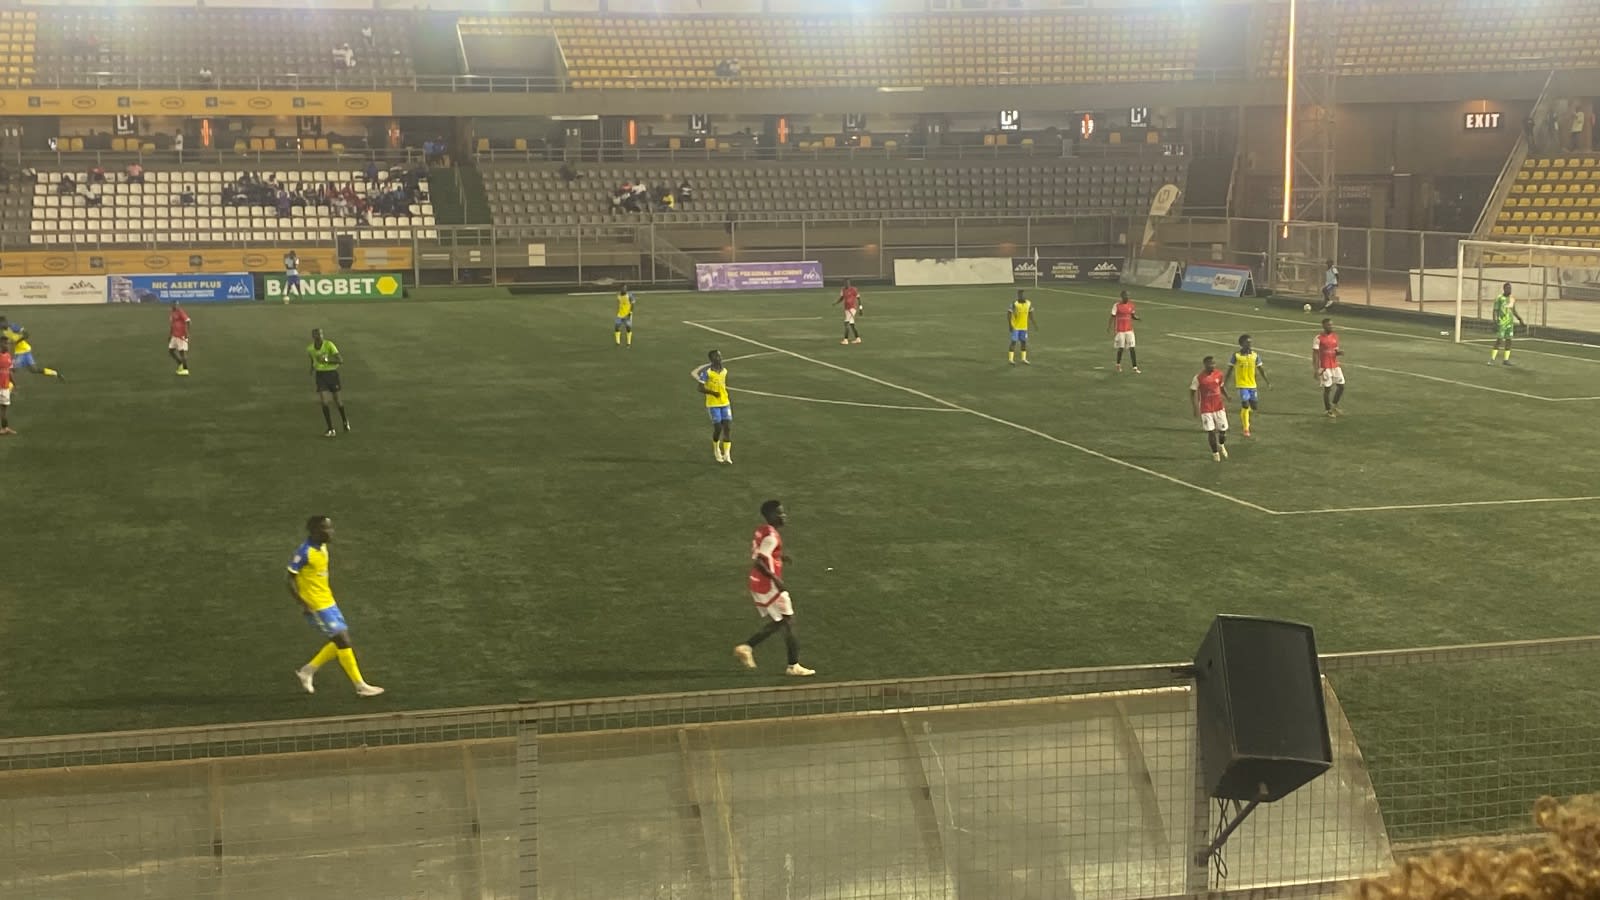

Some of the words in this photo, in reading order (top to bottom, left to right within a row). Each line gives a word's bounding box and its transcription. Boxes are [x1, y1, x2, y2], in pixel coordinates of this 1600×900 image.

[1467, 113, 1500, 128] EXIT
[152, 281, 168, 289] NIC
[170, 281, 198, 289] ASSET
[199, 280, 222, 289] PLUS
[266, 279, 375, 295] BANGBET
